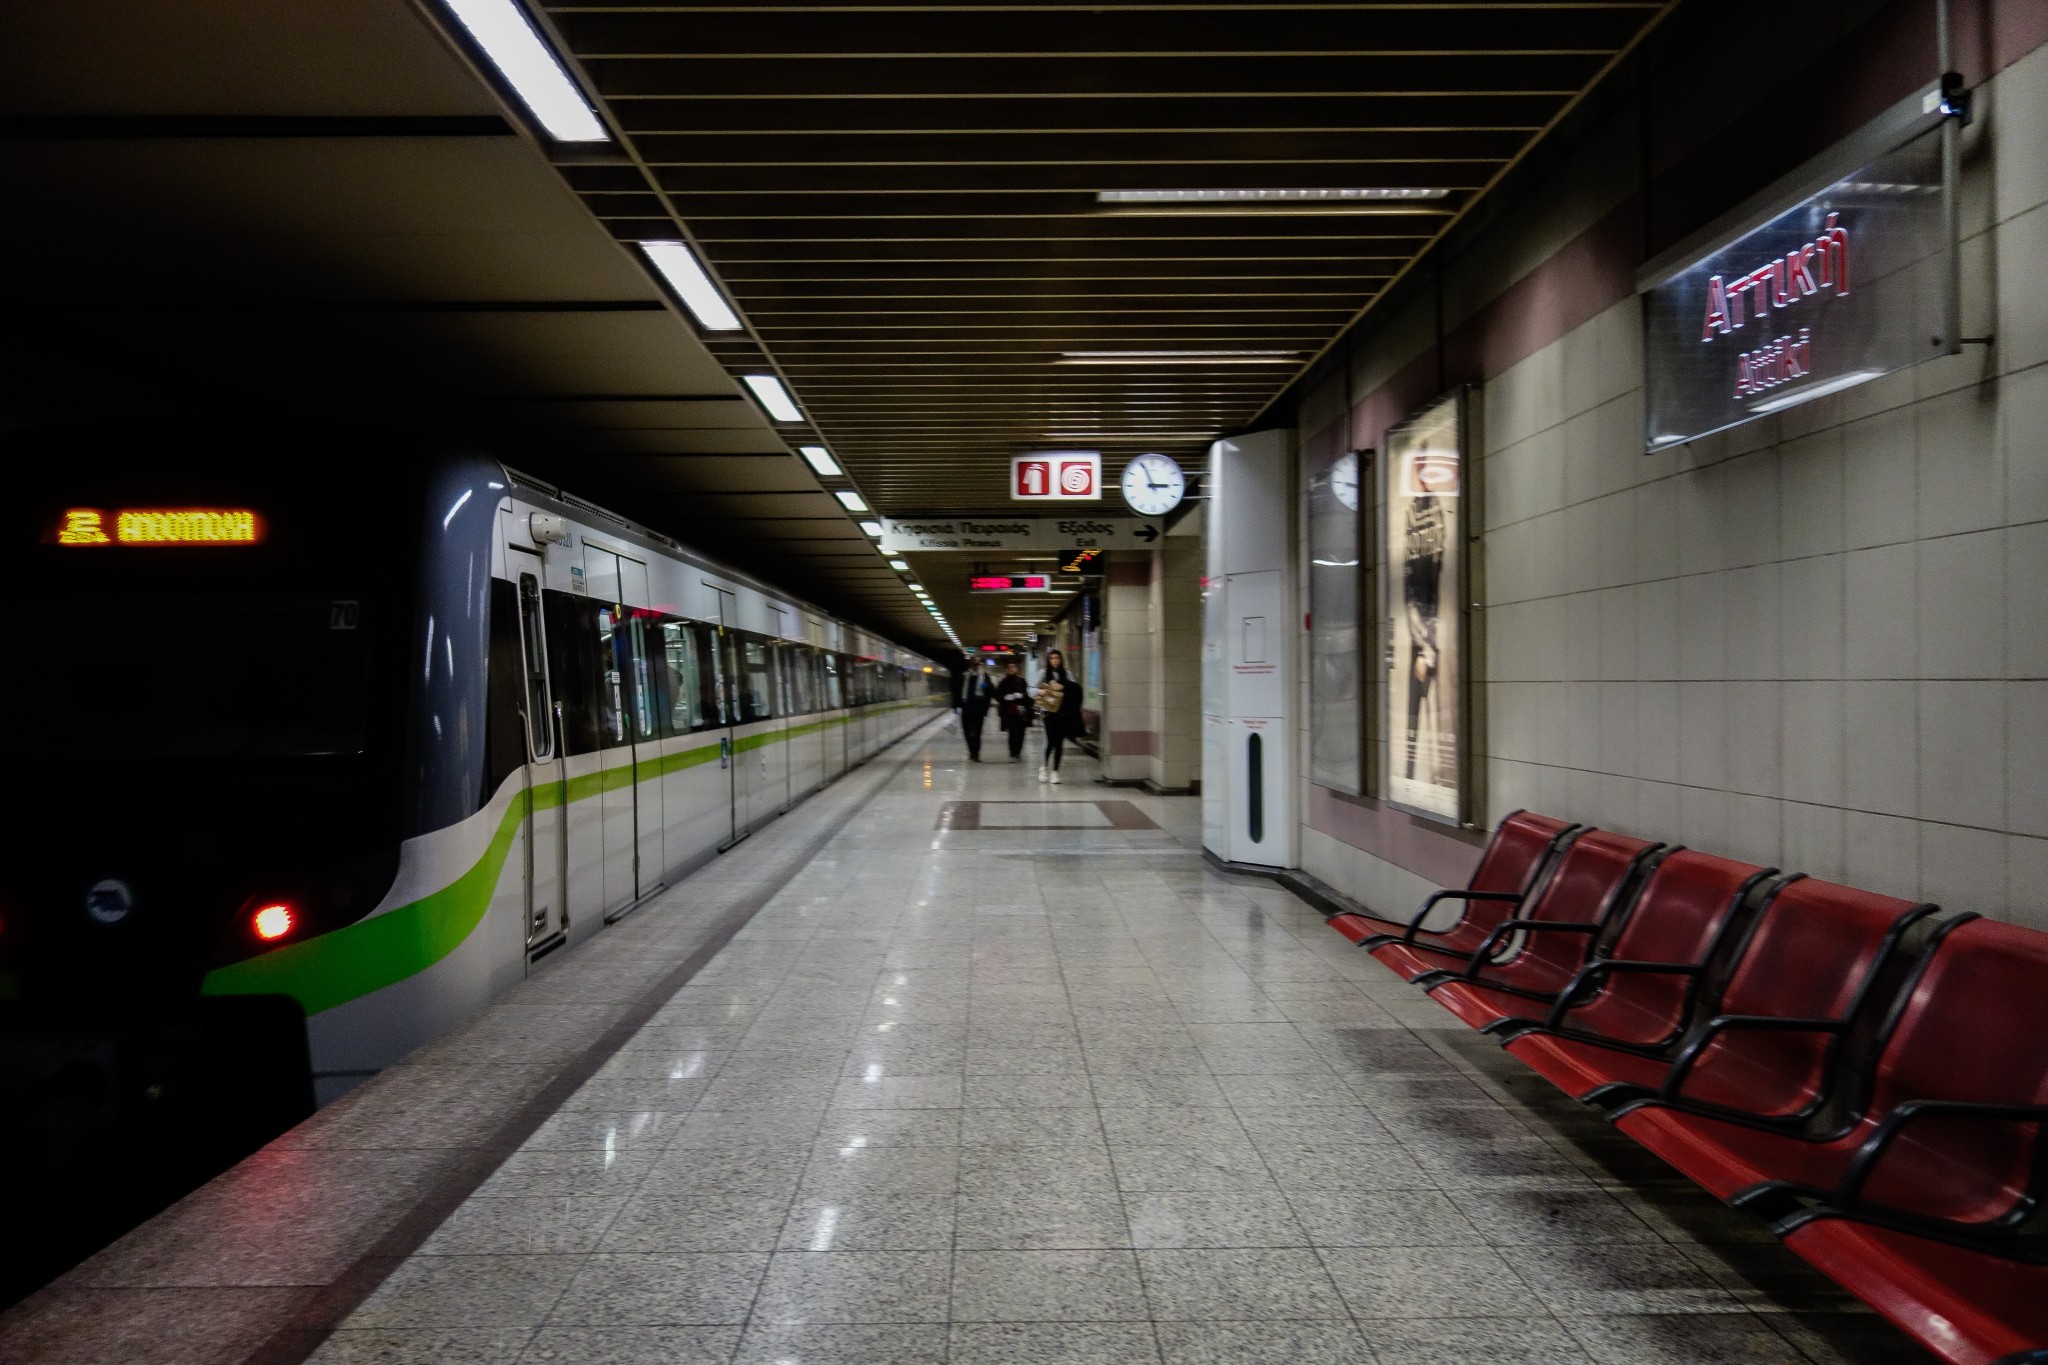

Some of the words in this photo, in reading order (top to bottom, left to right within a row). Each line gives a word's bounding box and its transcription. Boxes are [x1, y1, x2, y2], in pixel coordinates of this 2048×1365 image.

[1701, 211, 1849, 342] Αττική
[1733, 327, 1811, 399] Attiki
[1075, 538, 1097, 547] Exit
